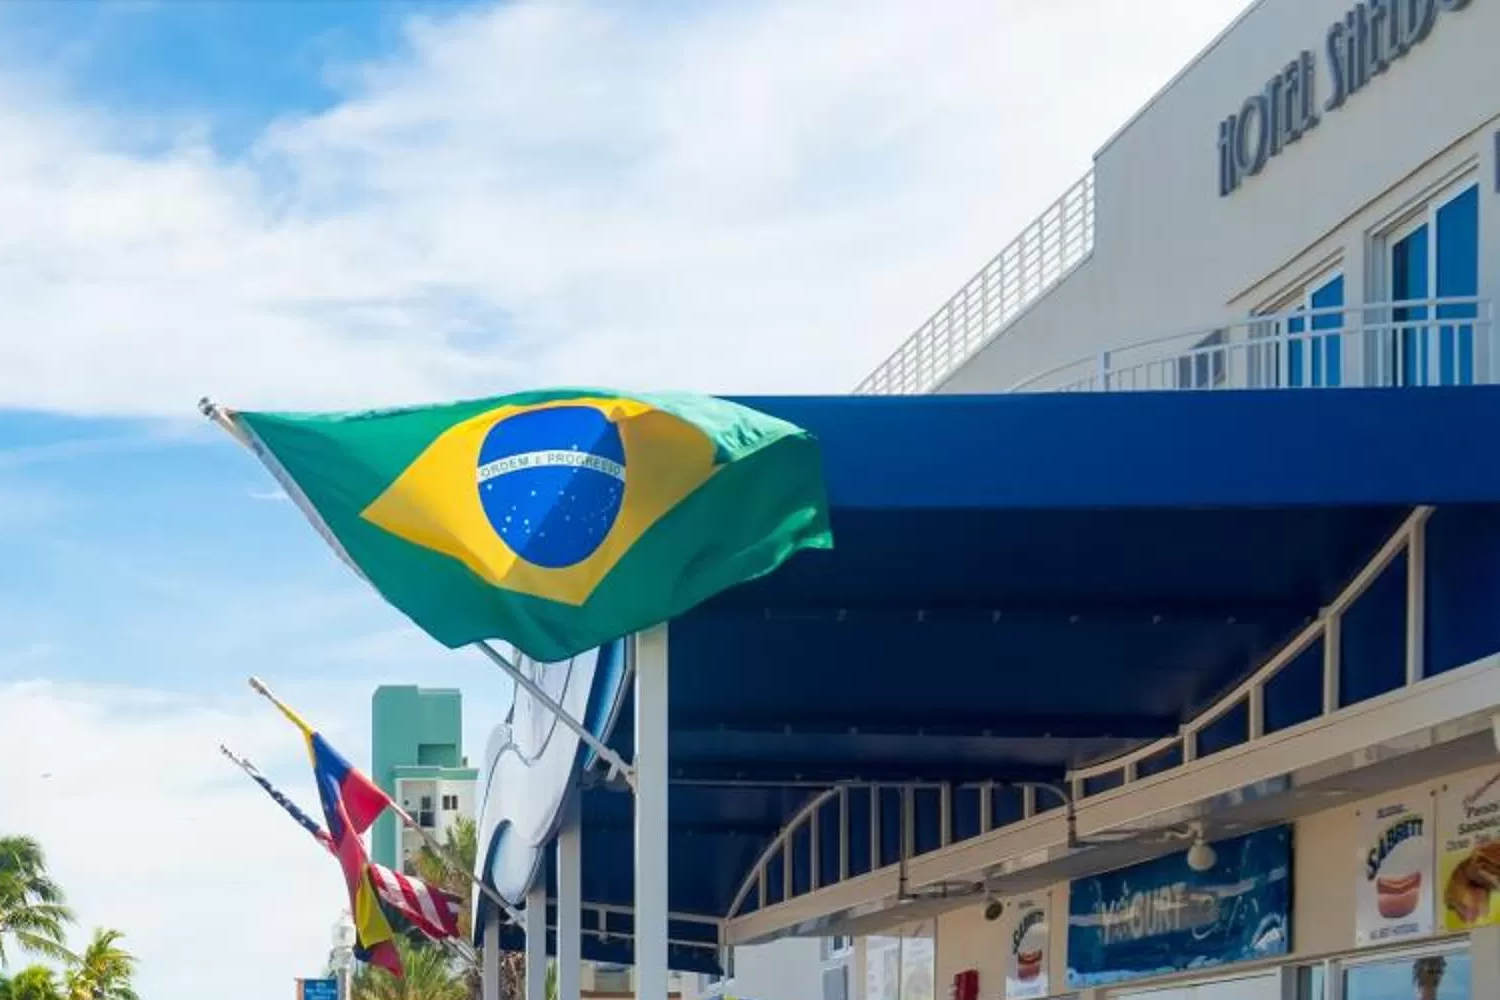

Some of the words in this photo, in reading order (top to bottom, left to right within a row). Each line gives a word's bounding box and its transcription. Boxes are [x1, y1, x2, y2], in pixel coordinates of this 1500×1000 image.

[1217, 50, 1321, 198] HOTEL
[1325, 0, 1476, 112] SHELD
[480, 456, 529, 479] ORDEM
[547, 453, 621, 477] PROGRESSO
